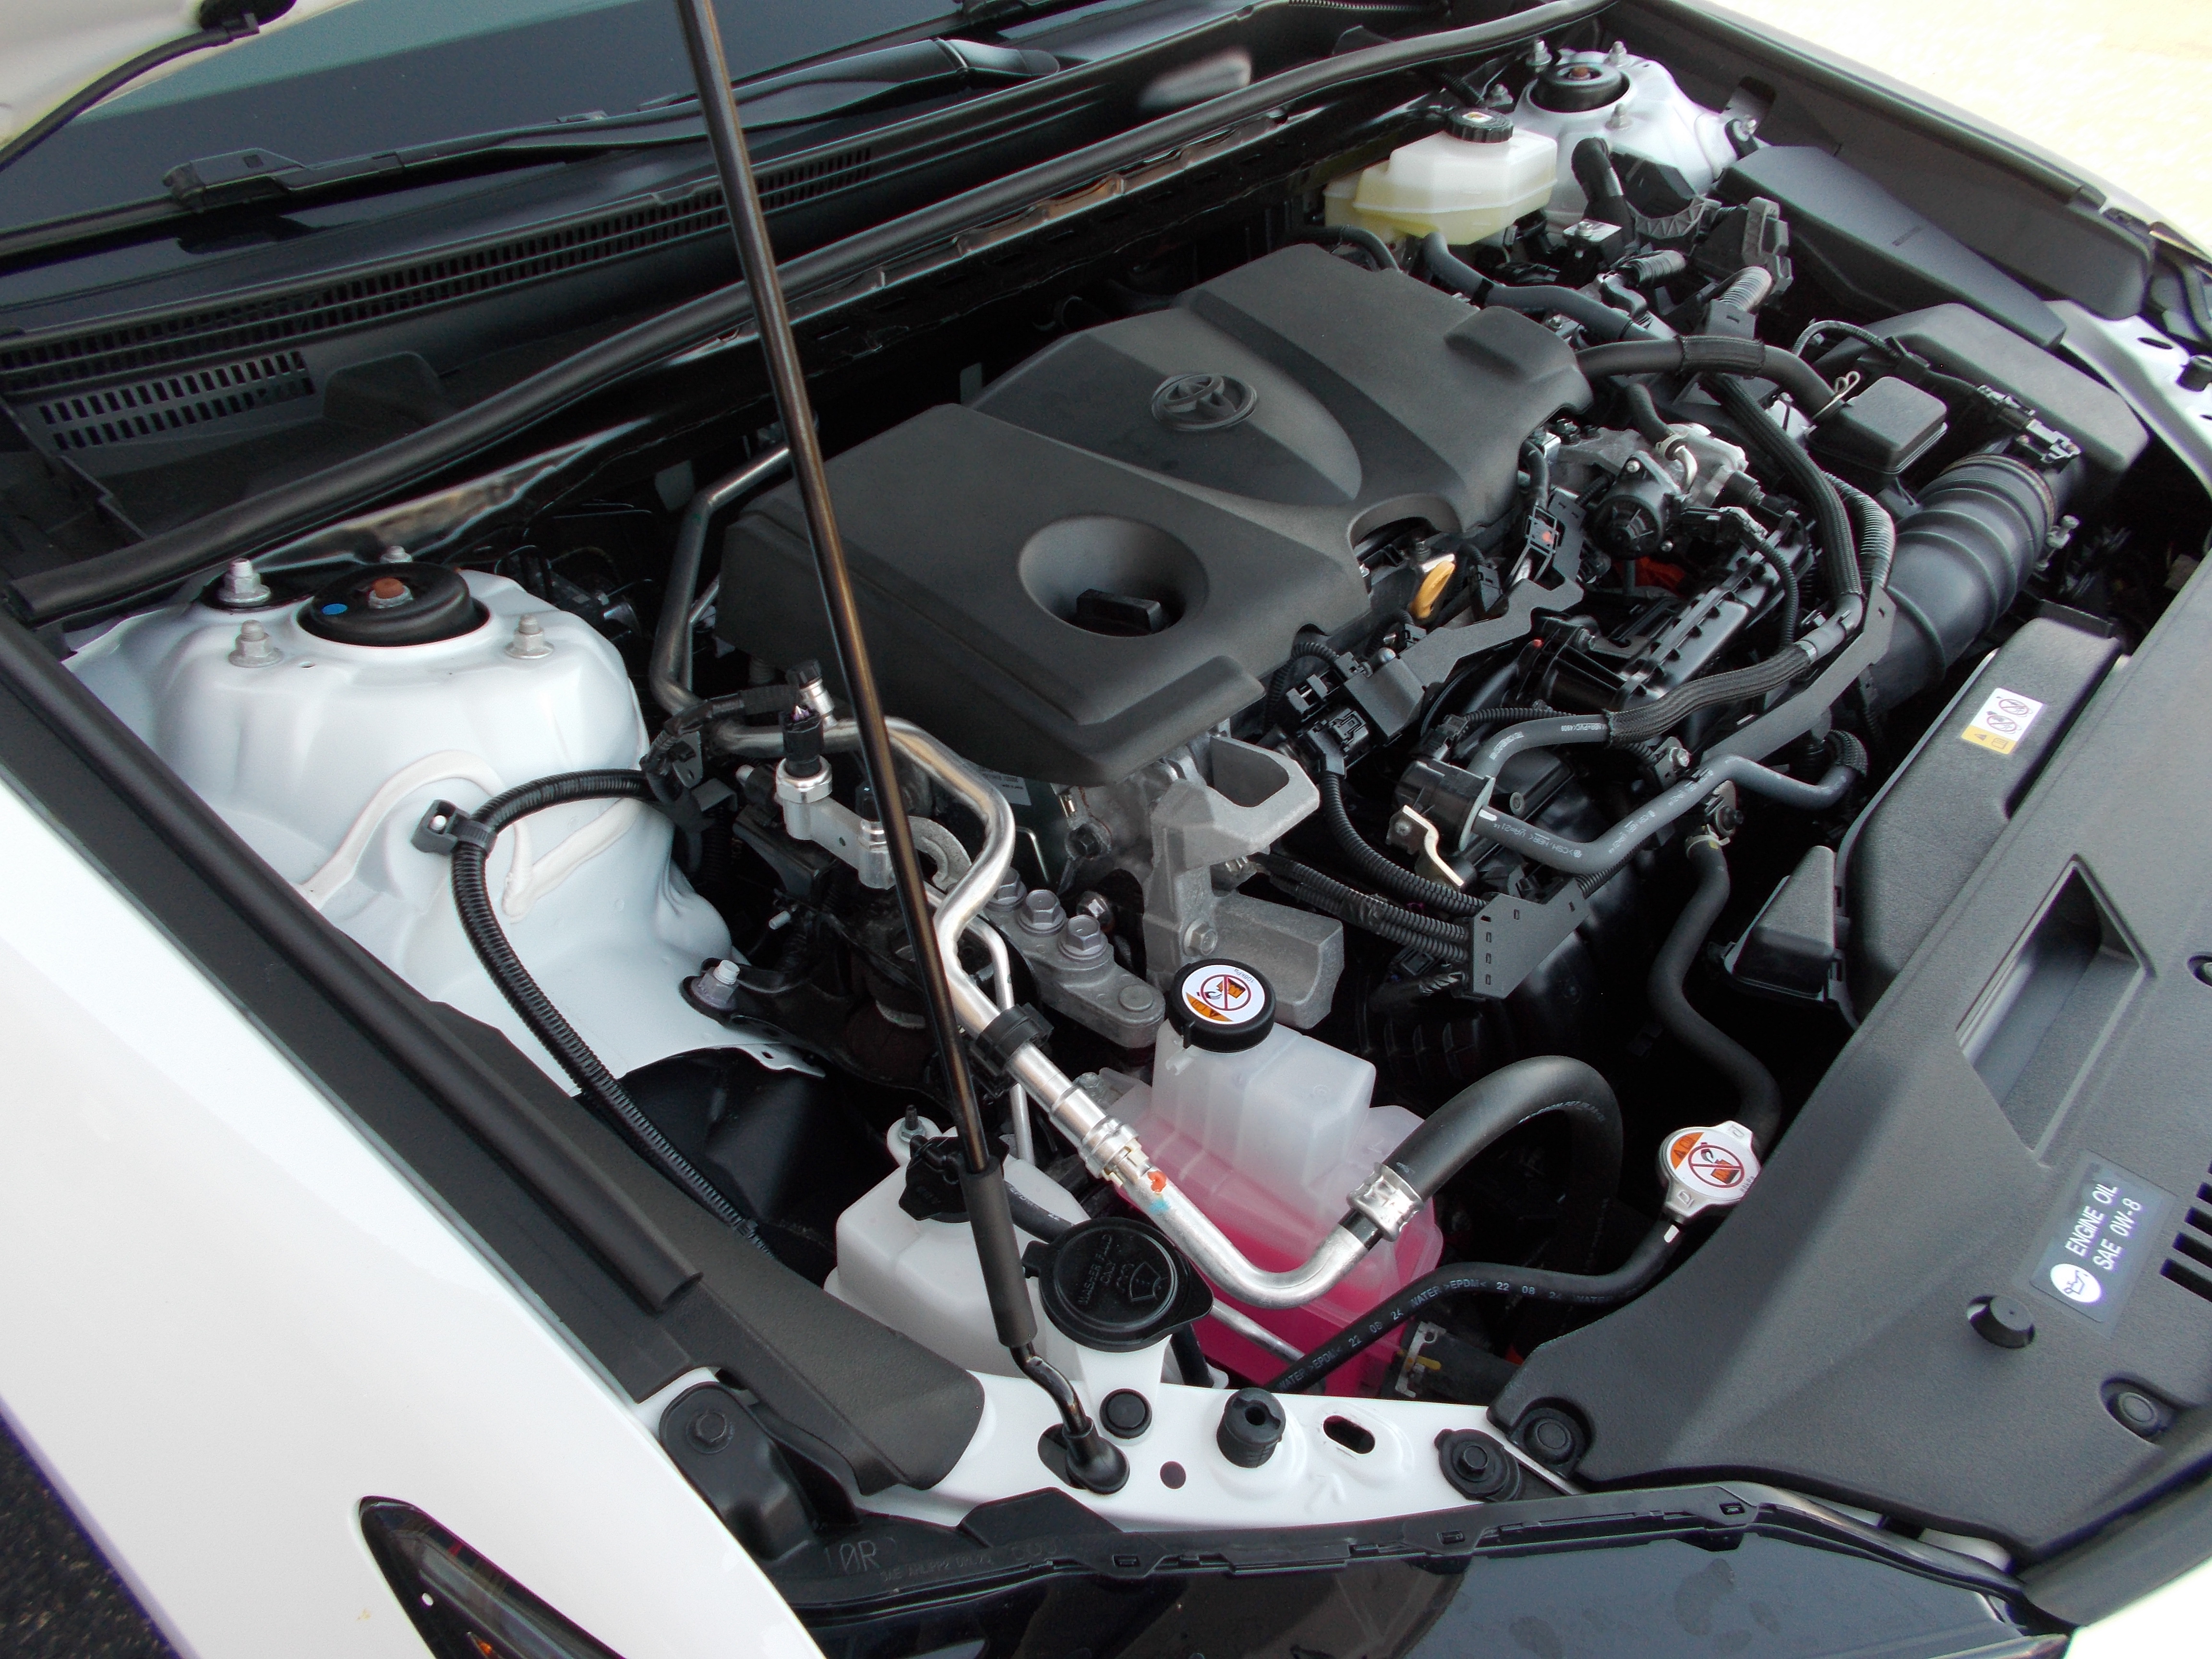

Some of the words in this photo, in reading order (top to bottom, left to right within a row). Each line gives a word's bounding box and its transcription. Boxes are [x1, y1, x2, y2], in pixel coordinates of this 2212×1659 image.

[1235, 969, 1254, 983] 108kPa
[2065, 1206, 2105, 1257] ENGINE
[2092, 1183, 2120, 1204] OIL
[2092, 1238, 2124, 1271] SAE
[2109, 1198, 2143, 1238] 0W-8
[1078, 1263, 1102, 1305] WASHER
[1094, 1234, 1113, 1261] FLUID
[1099, 1260, 1117, 1286] ONLY
[1277, 1368, 1308, 1392] WATER
[1347, 1334, 1362, 1348] 22
[1369, 1321, 1383, 1334] 08
[1390, 1308, 1404, 1321] 24
[1409, 1286, 1442, 1308] WATER
[1443, 1278, 1486, 1291] >EPDM<
[1496, 1281, 1510, 1291] 22
[1521, 1285, 1536, 1295] 08
